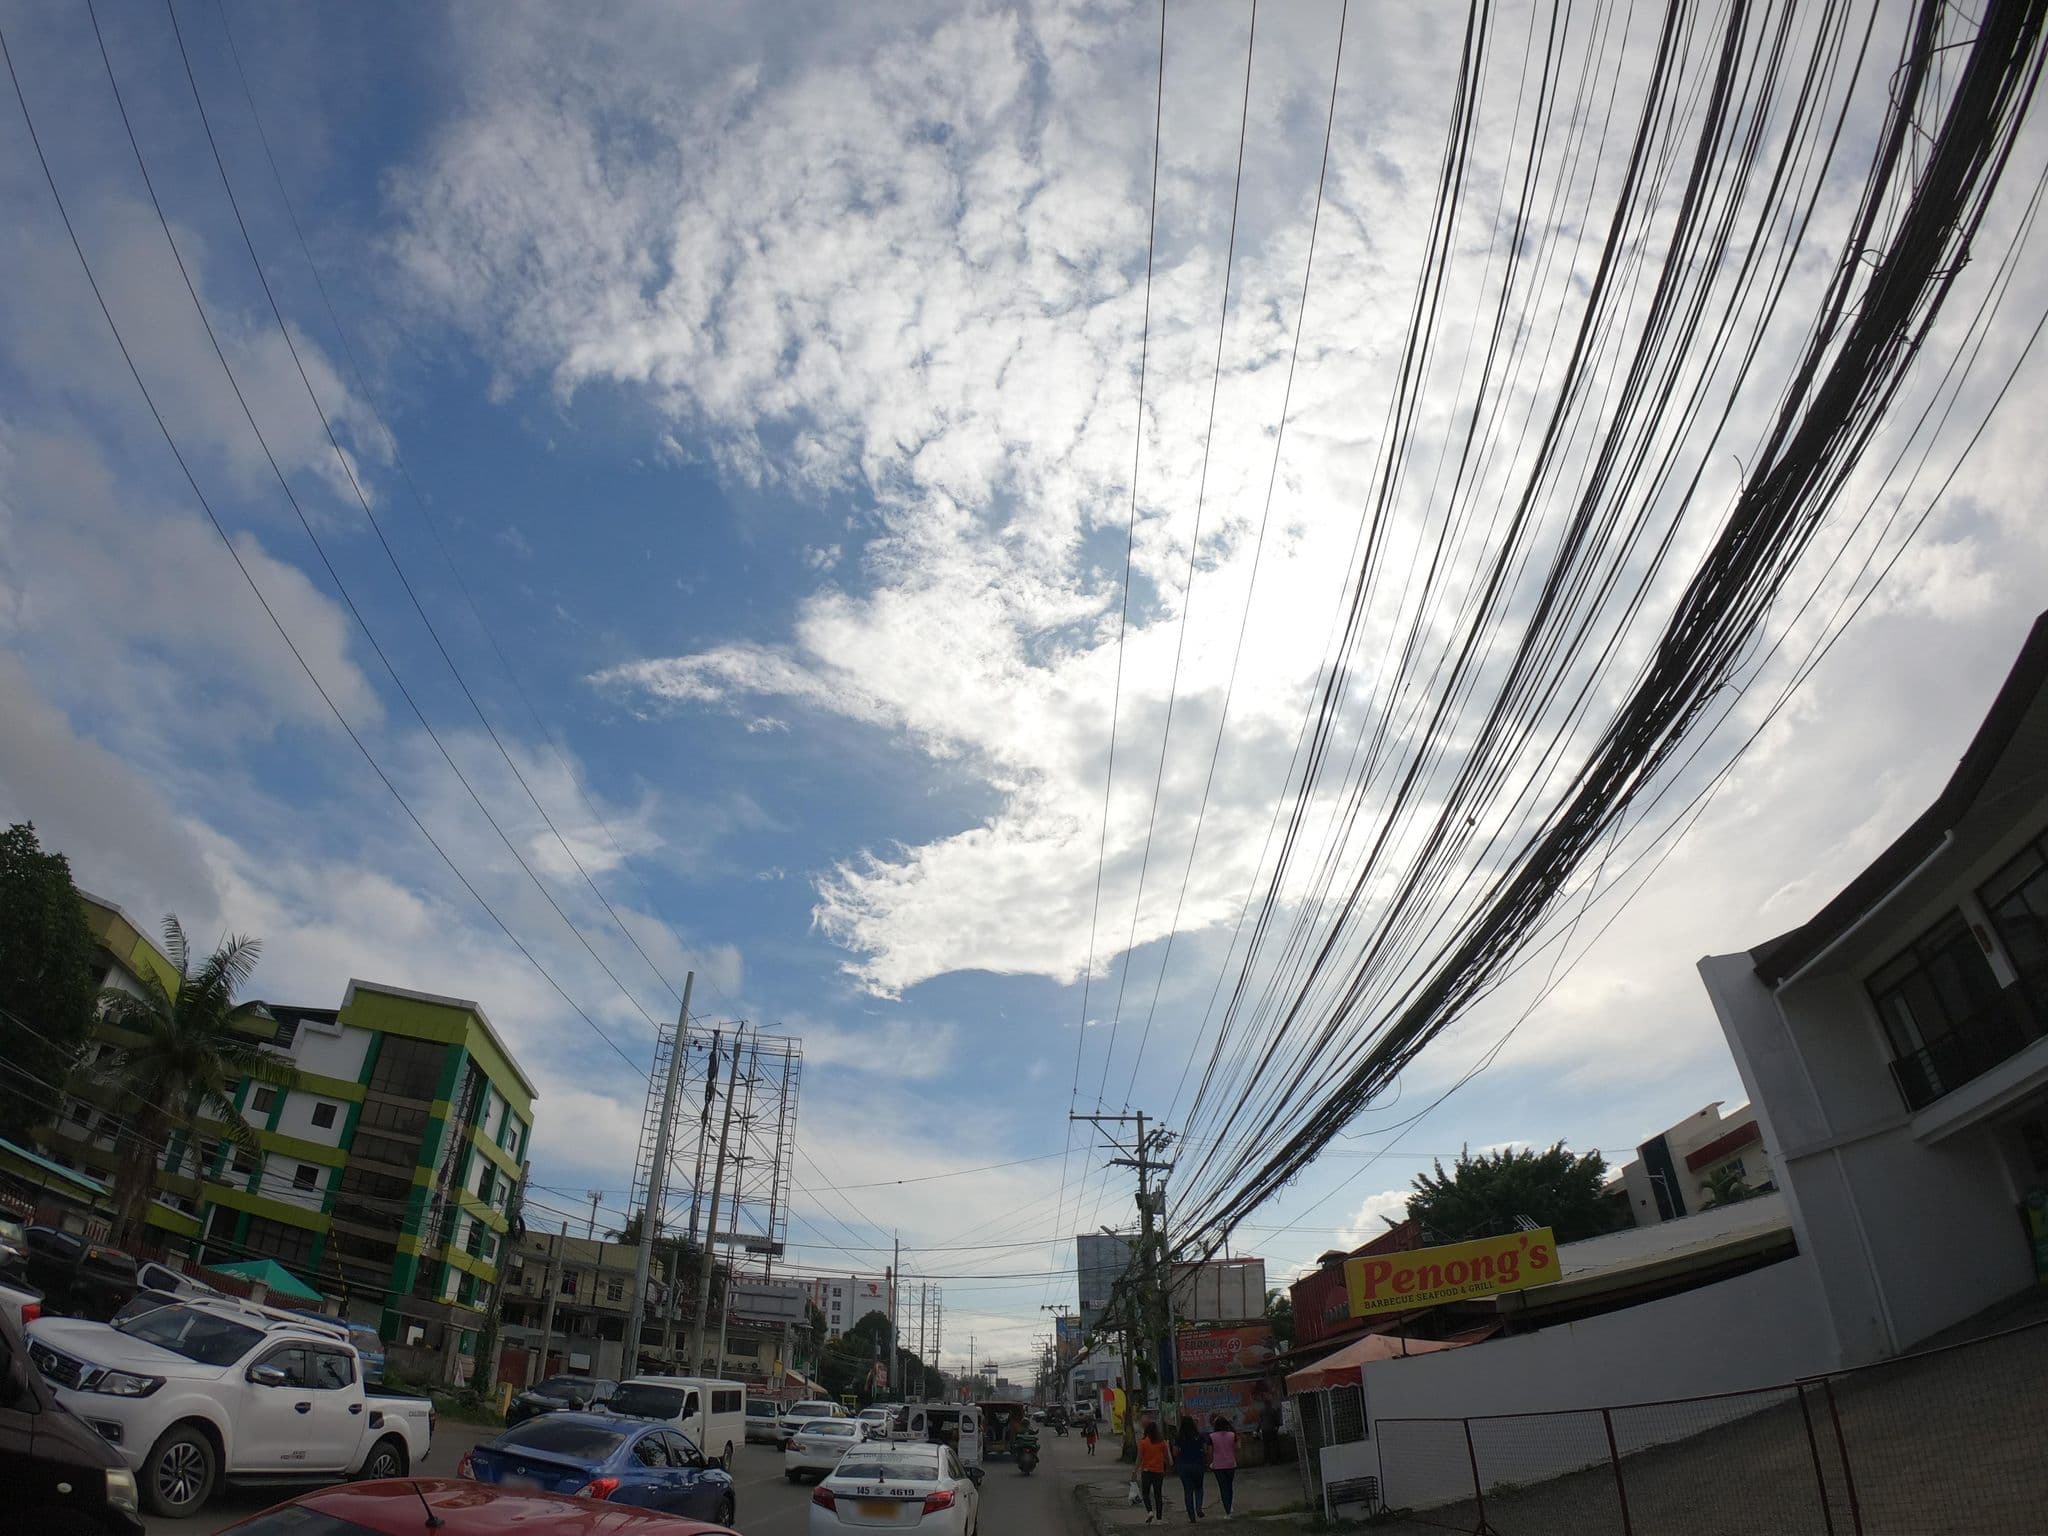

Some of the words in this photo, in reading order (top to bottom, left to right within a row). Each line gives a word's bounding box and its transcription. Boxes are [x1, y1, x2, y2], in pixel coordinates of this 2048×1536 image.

[1363, 1236, 1549, 1300] Penong's
[1364, 1294, 1414, 1310] BARBECUE
[1417, 1288, 1458, 1302] SEAFOOD
[1468, 1281, 1495, 1292] GRILL
[857, 1486, 870, 1494] 145
